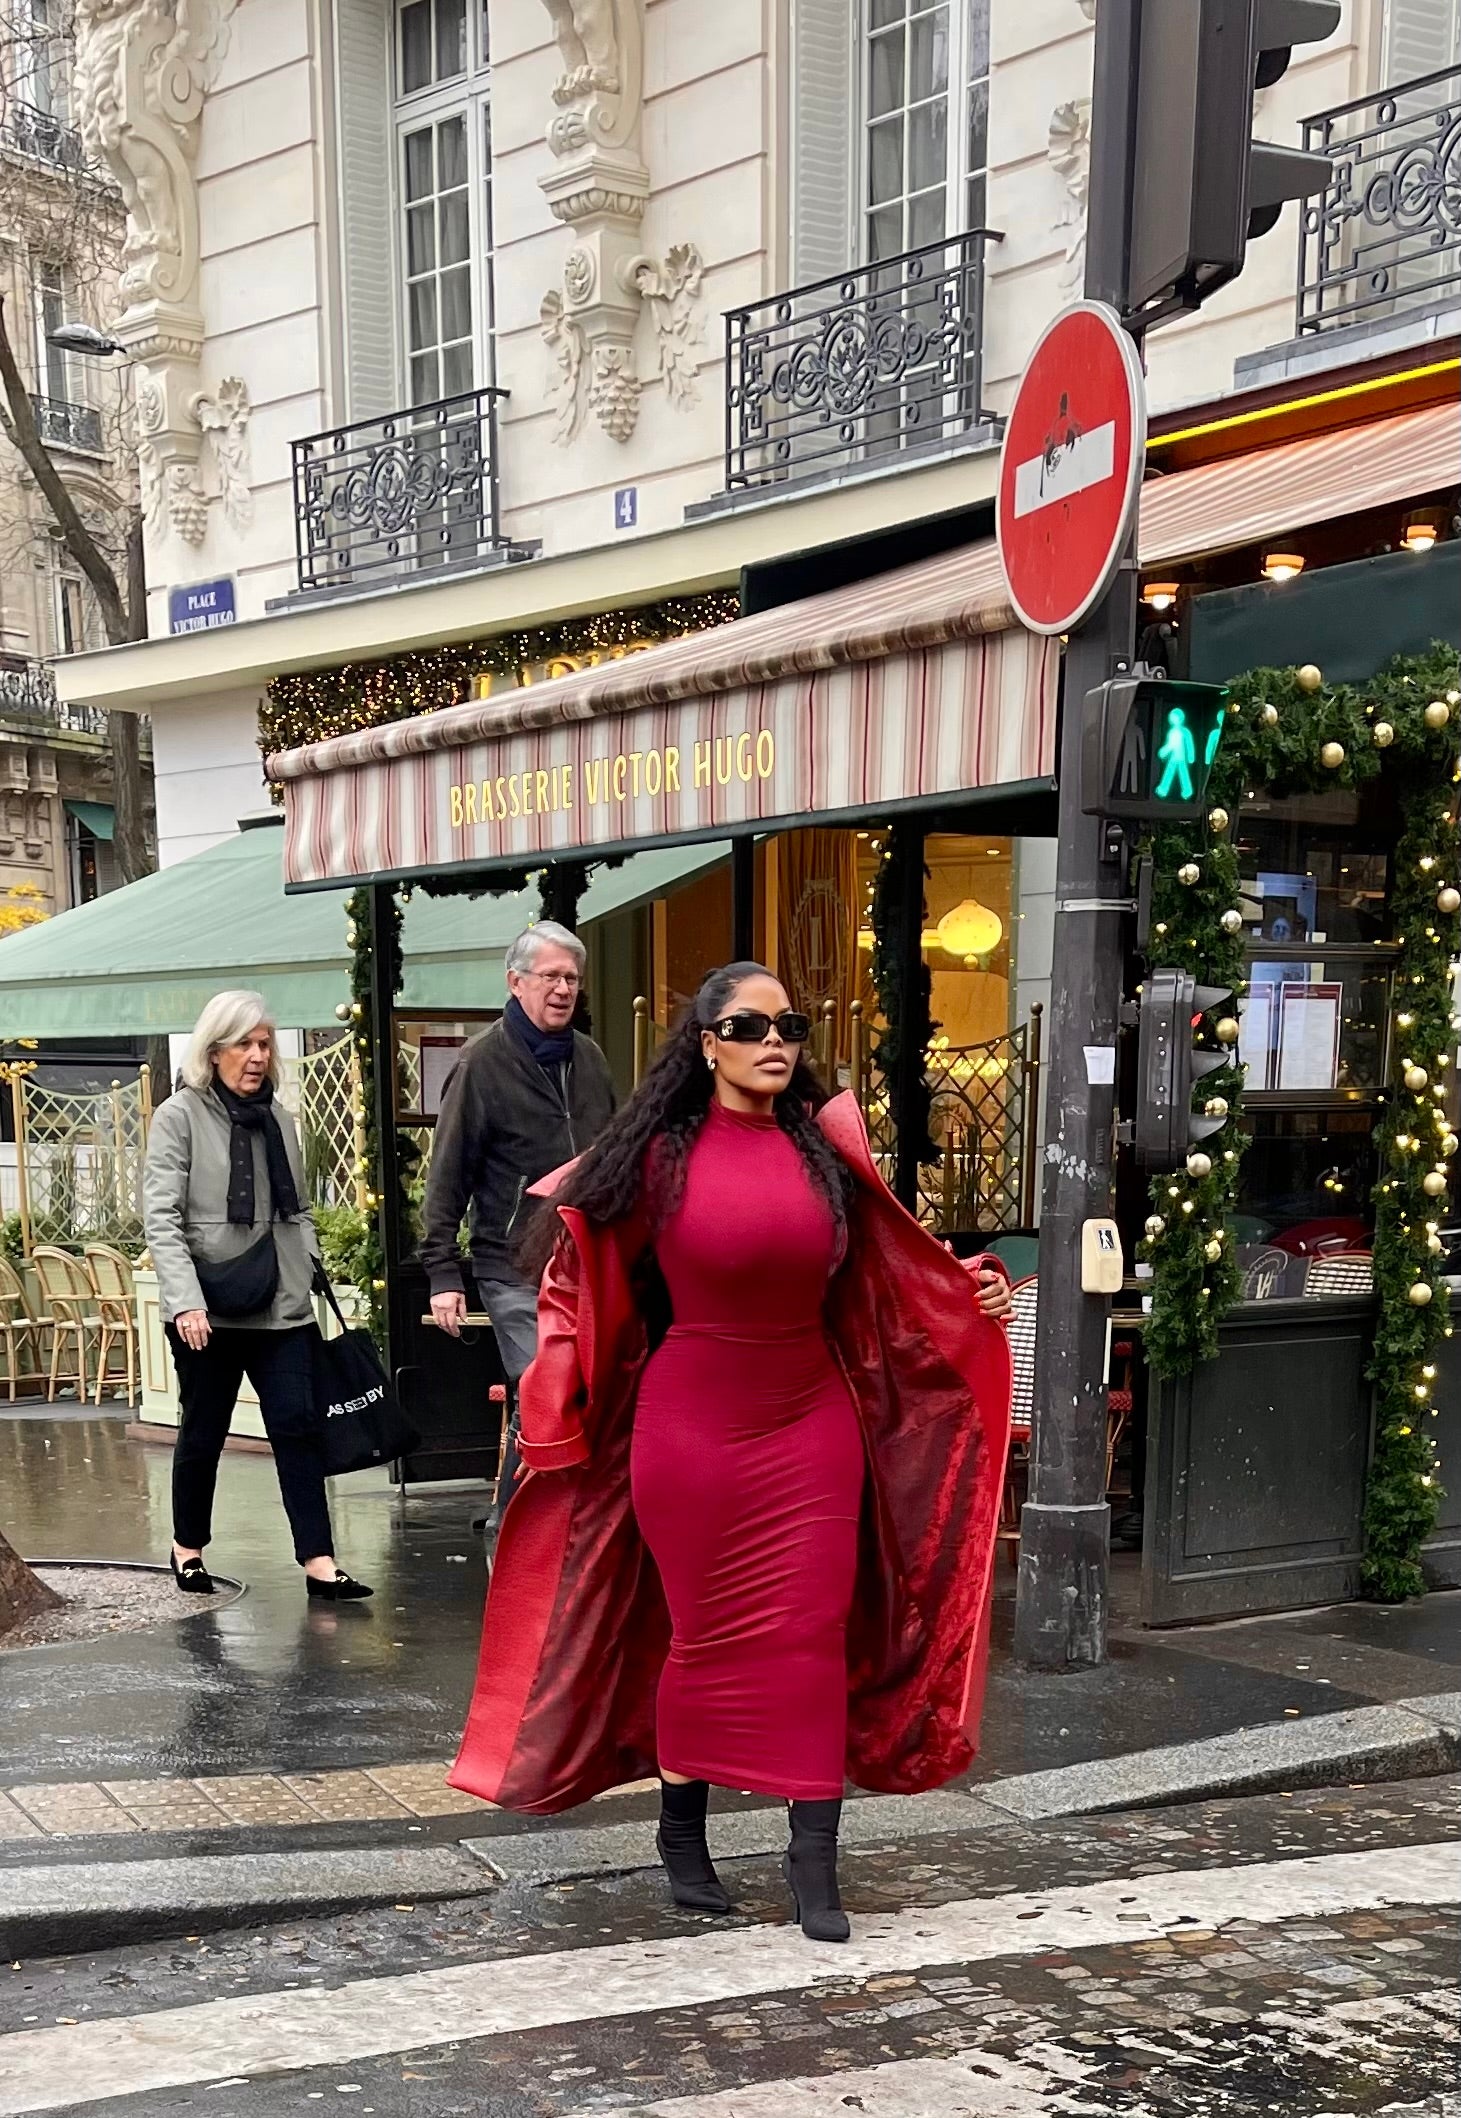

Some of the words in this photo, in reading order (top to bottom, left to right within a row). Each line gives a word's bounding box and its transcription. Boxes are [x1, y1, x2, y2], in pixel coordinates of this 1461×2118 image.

[620, 490, 632, 524] 4
[188, 592, 216, 610] PLACE
[174, 616, 206, 633] VICTOR
[208, 610, 233, 627] HUGO
[450, 764, 573, 828] BRASSERIE
[585, 745, 681, 805] VICTOR
[694, 729, 775, 789] HUGO
[327, 1404, 344, 1417] AS
[366, 1385, 384, 1402] BY
